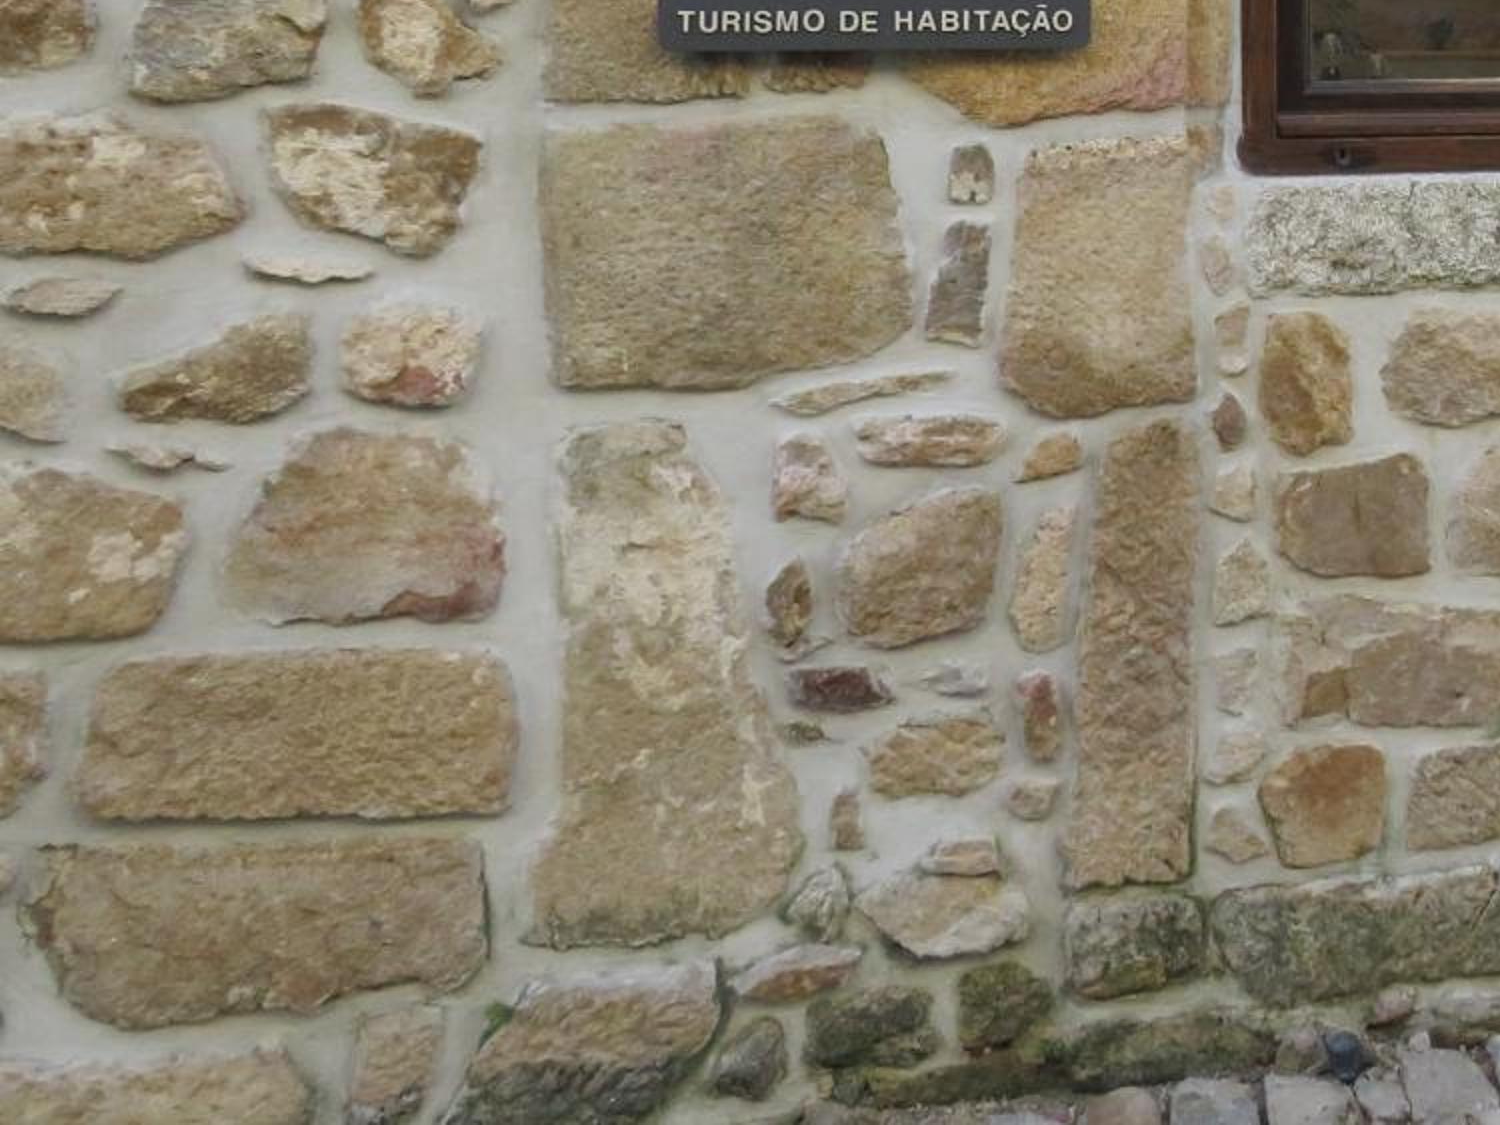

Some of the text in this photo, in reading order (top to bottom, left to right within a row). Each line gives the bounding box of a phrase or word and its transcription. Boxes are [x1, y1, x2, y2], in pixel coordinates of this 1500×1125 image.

[677, 4, 1075, 39] TURISMO DE HABITAÇÃO
